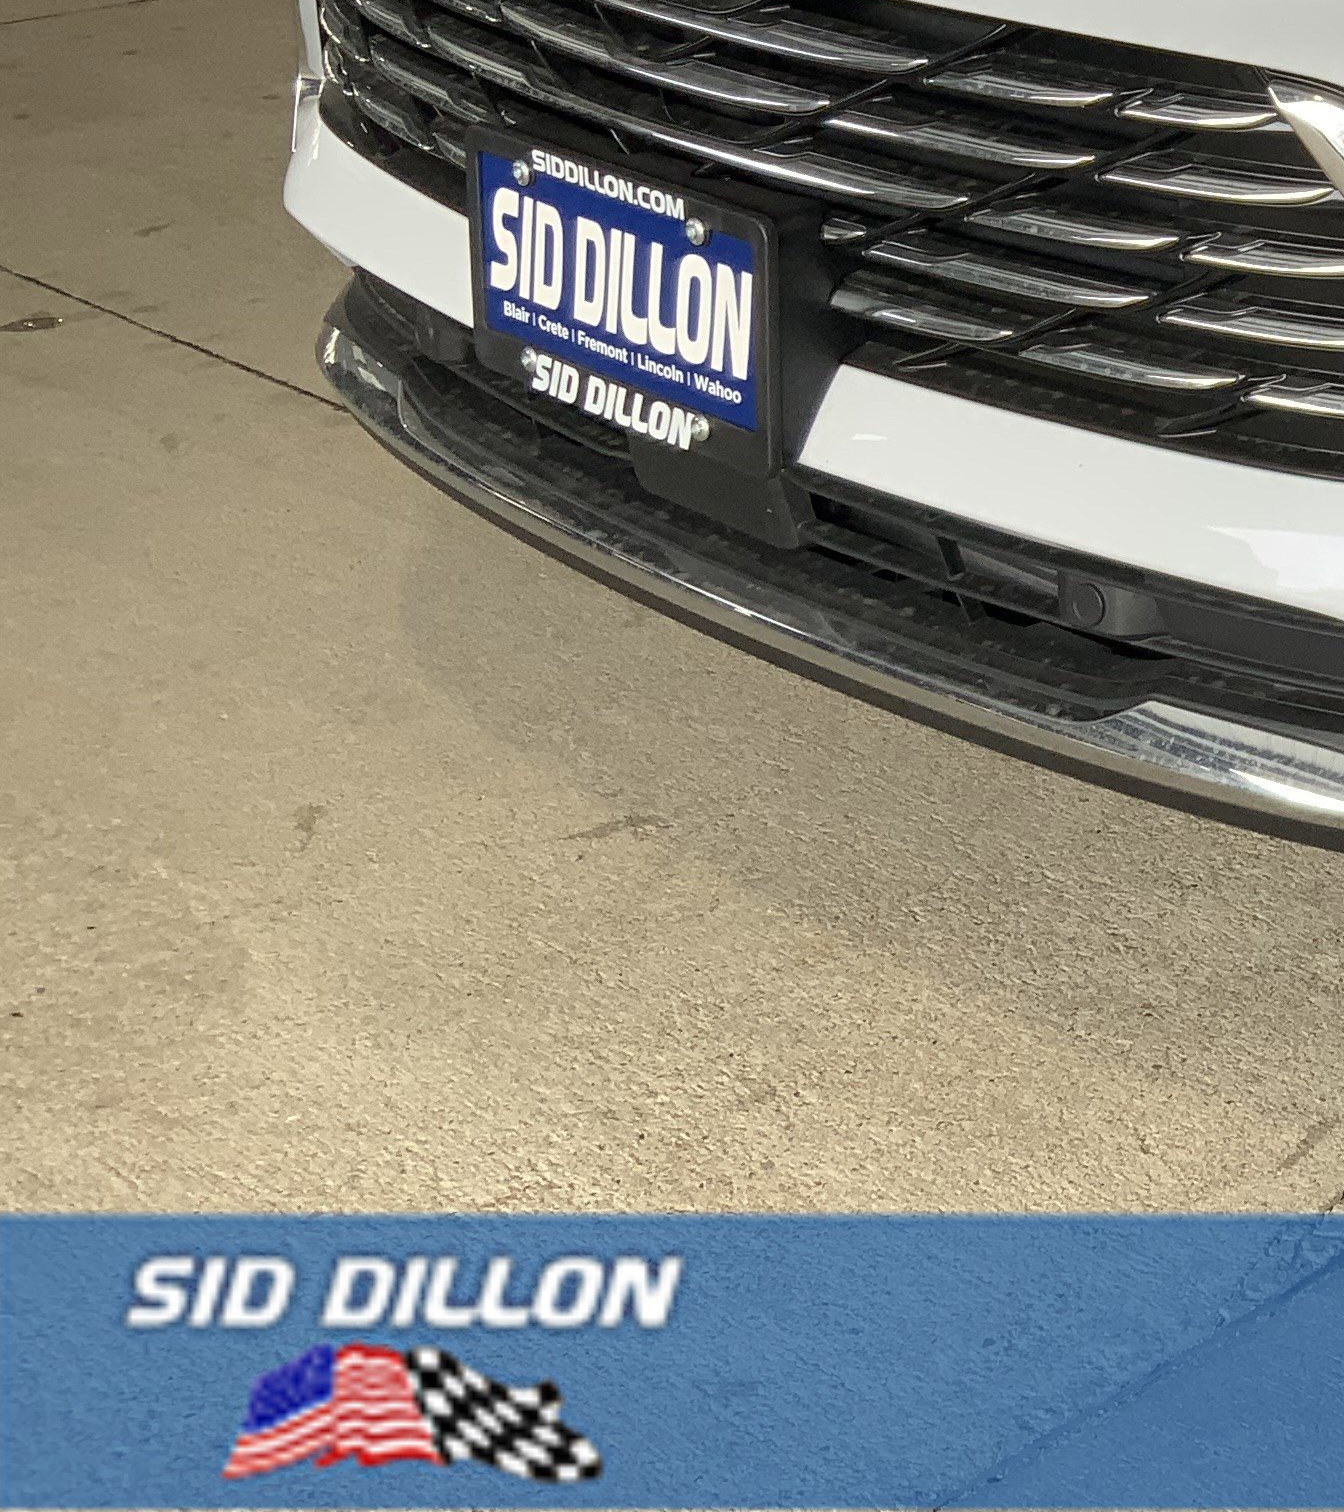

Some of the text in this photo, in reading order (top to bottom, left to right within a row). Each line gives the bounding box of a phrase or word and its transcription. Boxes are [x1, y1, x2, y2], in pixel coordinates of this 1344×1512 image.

[531, 149, 685, 221] SIDDILLON.COM
[489, 186, 753, 380] SID DILLON
[503, 300, 742, 405] Blair Crete Fremont Lincoln Wahoo
[531, 354, 694, 451] SID DILLON
